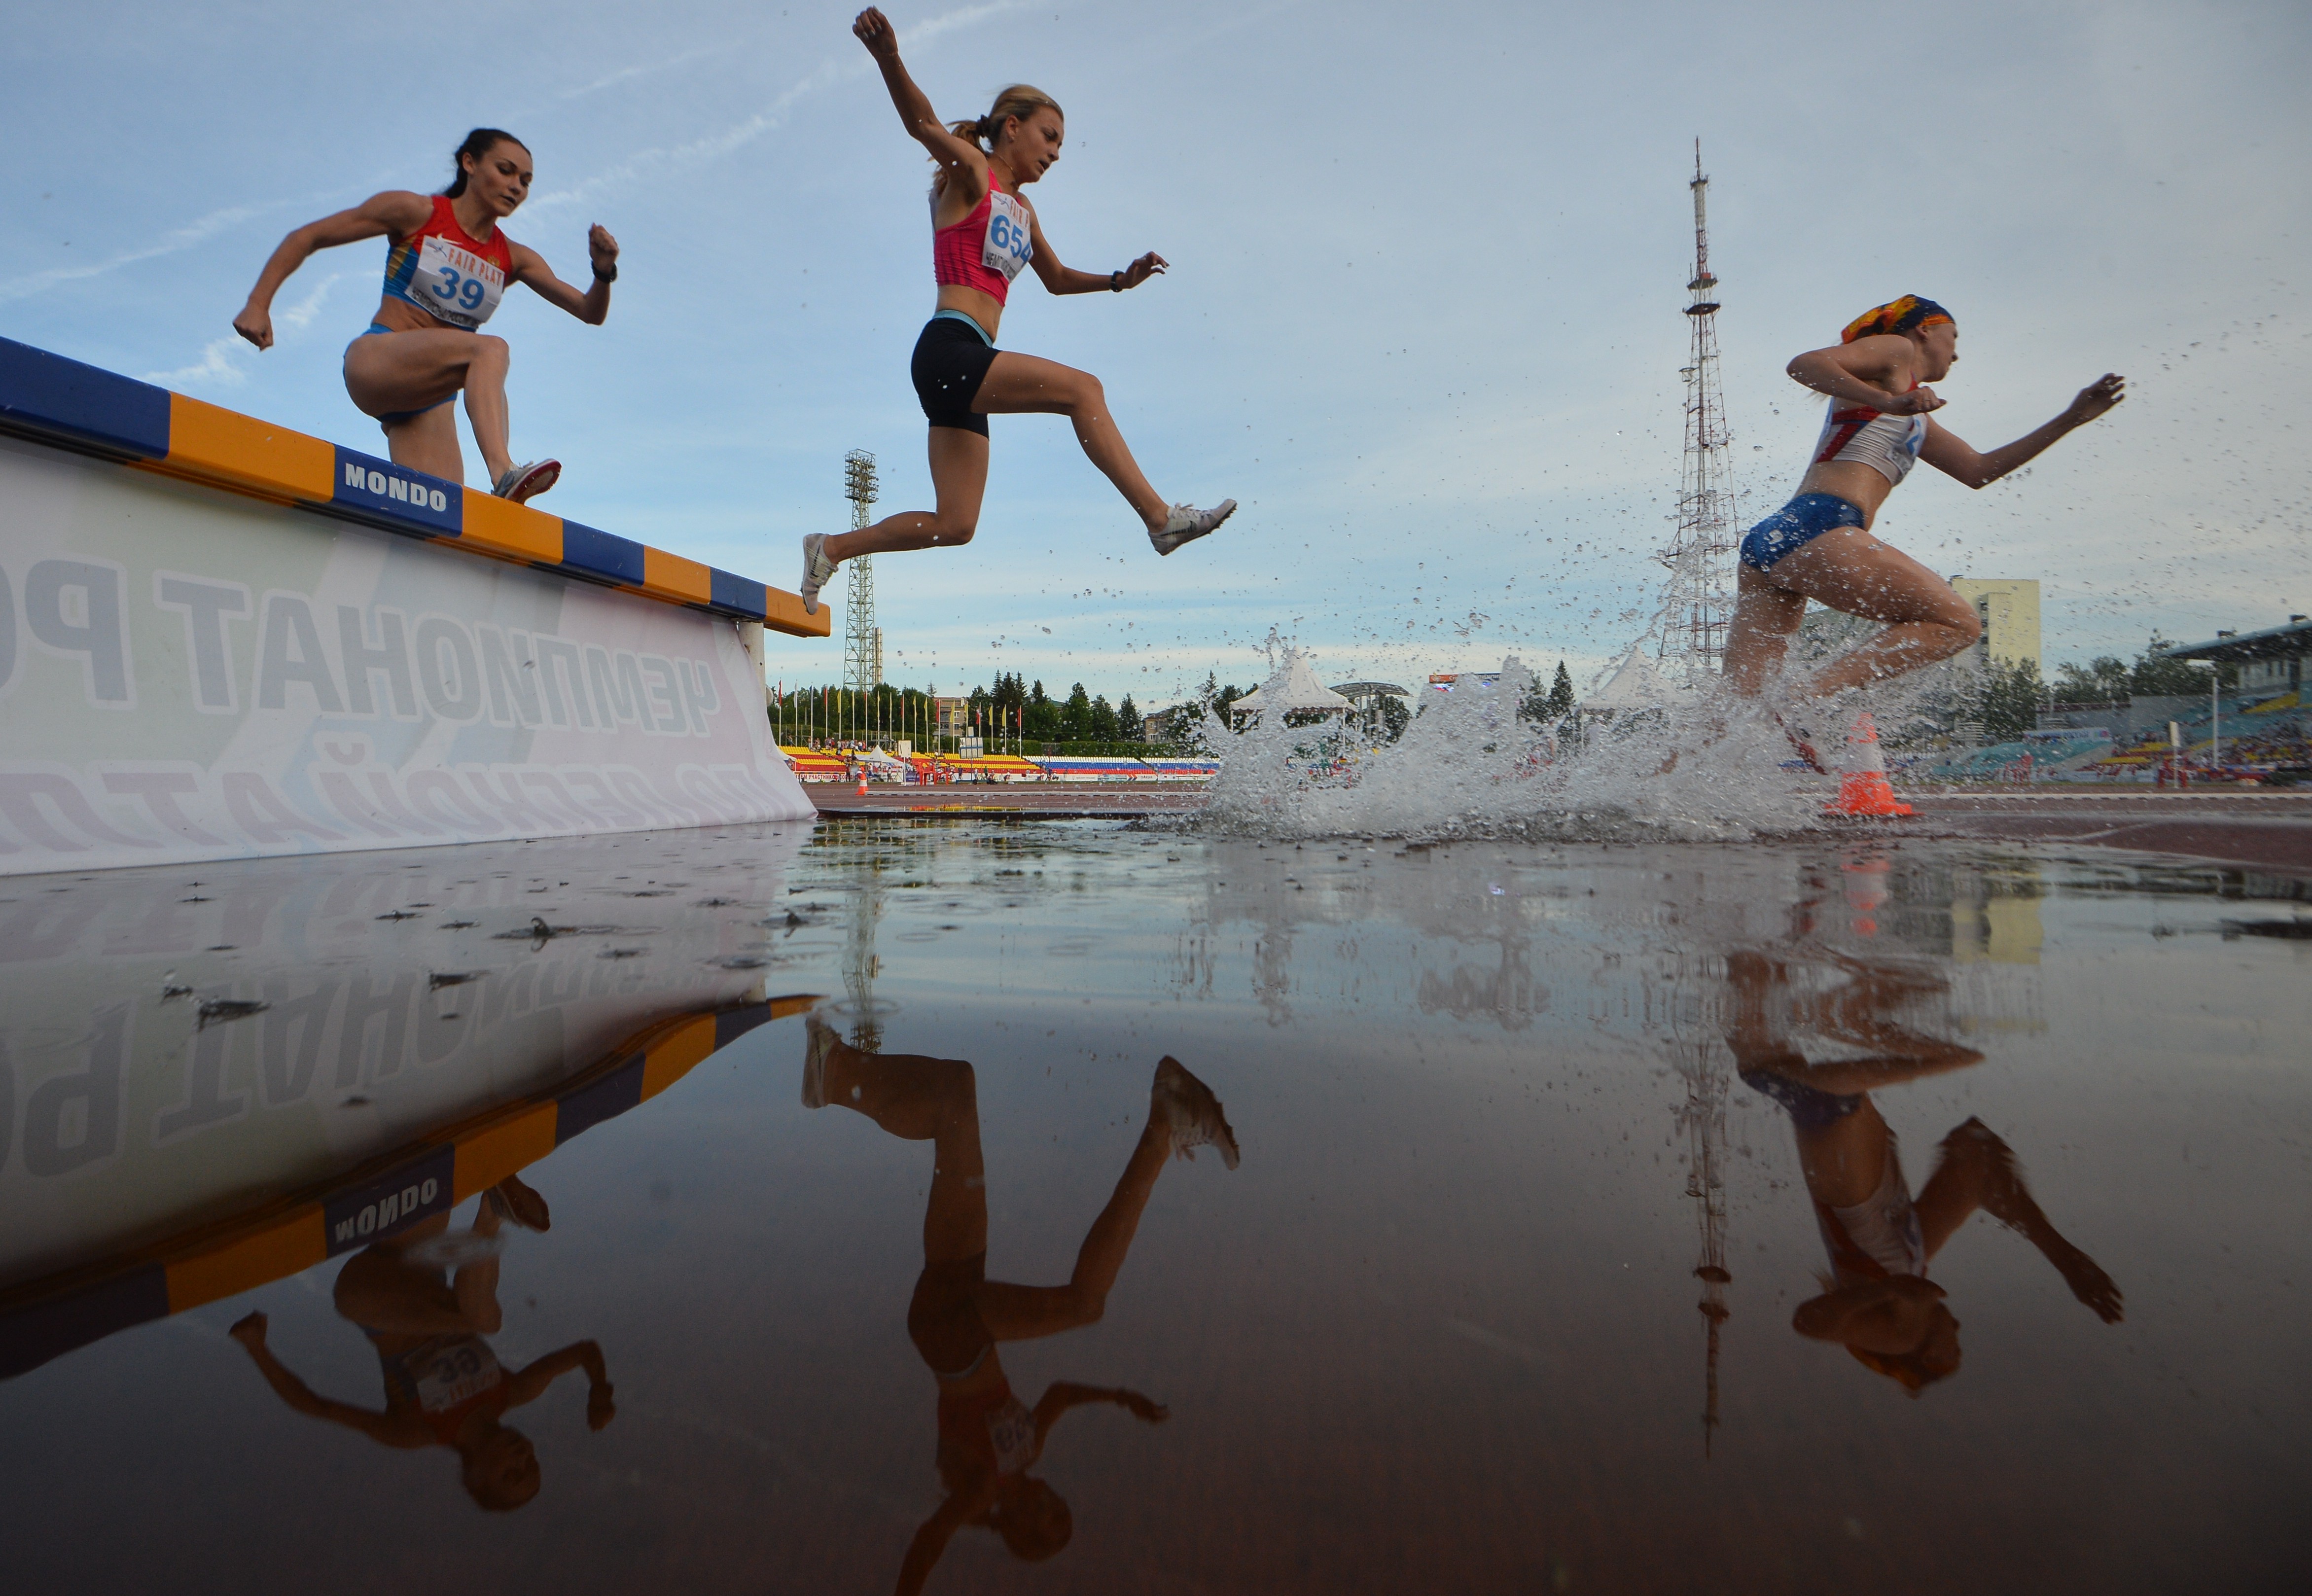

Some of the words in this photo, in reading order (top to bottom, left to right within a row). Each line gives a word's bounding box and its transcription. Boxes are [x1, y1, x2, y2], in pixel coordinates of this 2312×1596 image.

[991, 214, 1031, 267] 654
[432, 266, 484, 310] 39
[448, 248, 476, 273] FAIR
[478, 262, 502, 286] PLAY
[345, 462, 446, 512] MONDO
